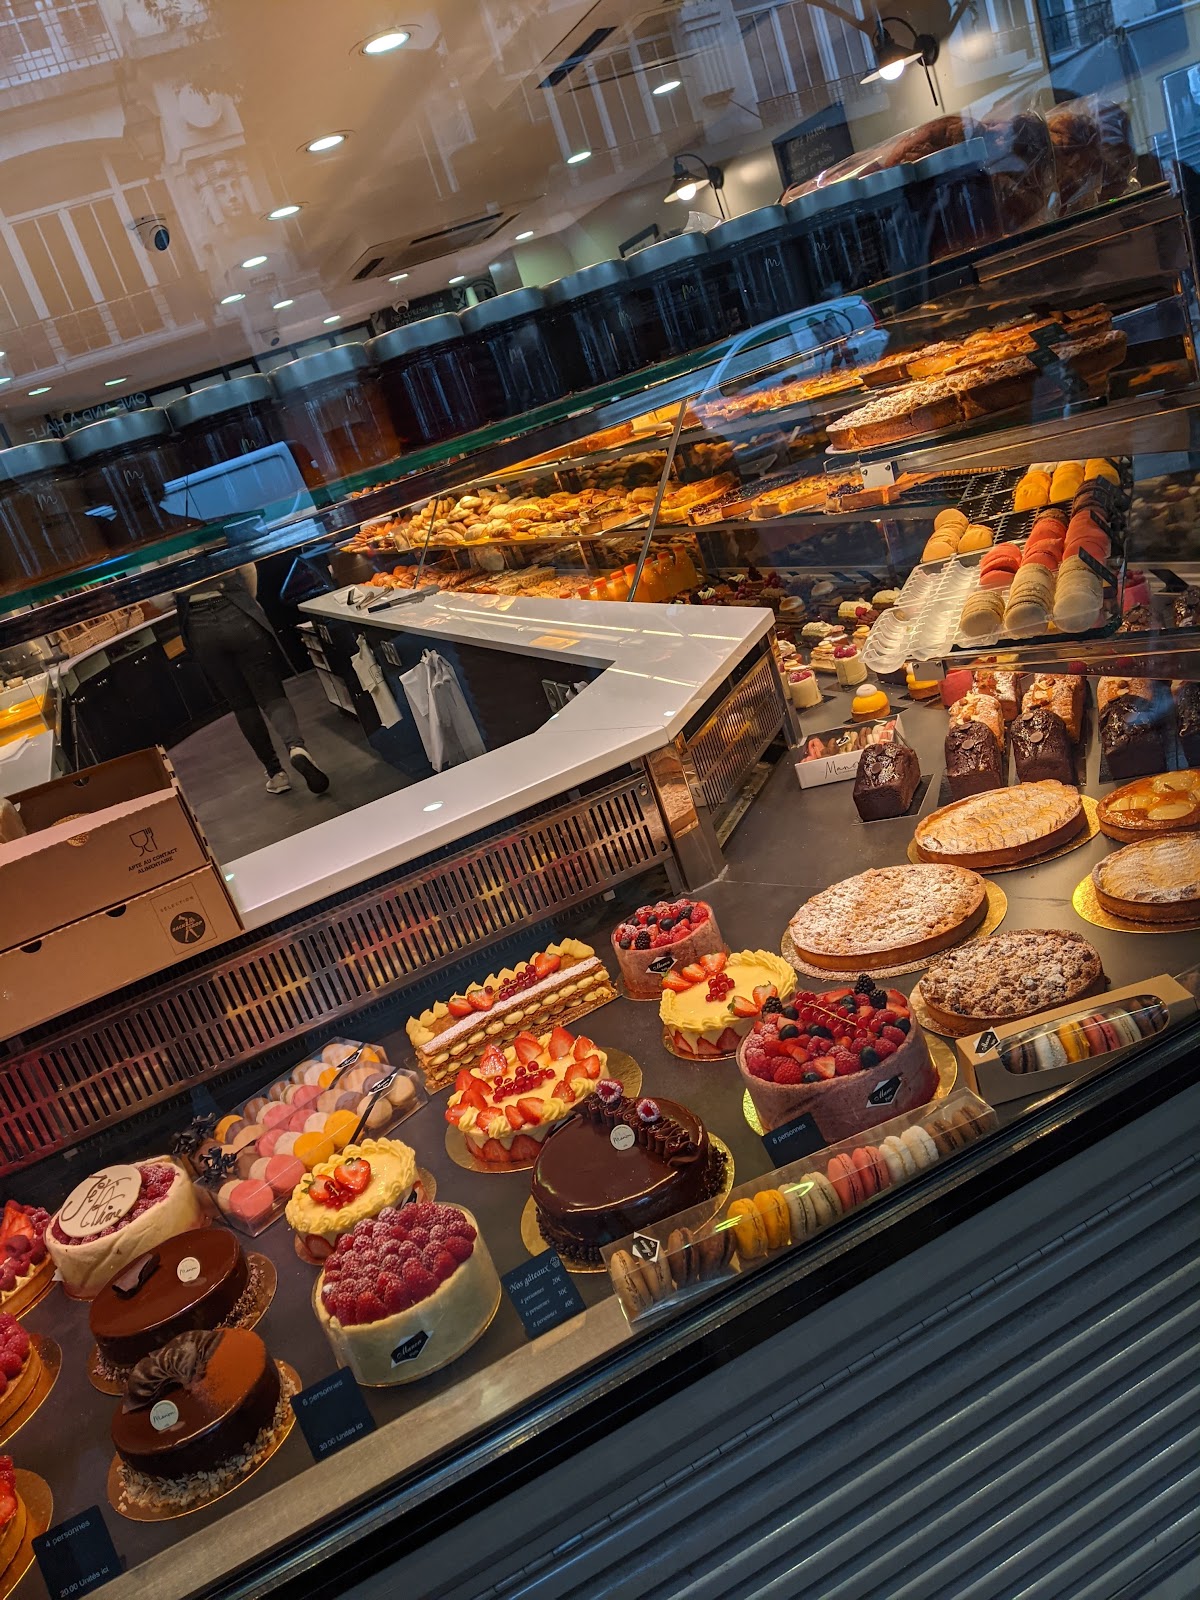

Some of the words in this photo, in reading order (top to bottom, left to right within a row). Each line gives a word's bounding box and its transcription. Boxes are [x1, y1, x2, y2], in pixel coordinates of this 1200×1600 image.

[825, 760, 858, 779] Mano
[128, 862, 143, 872] APTE
[143, 858, 152, 867] AU
[152, 847, 178, 861] CONTACT
[137, 856, 174, 874] ALIMENTAIRE
[777, 1123, 806, 1143] personnes
[509, 1279, 523, 1294] Nos
[523, 1264, 552, 1287] gâteaux
[523, 1287, 545, 1305] personnes
[529, 1299, 550, 1316] personnes
[536, 1310, 558, 1327] personnes
[302, 1398, 308, 1406] 6
[308, 1380, 343, 1404] personnes
[319, 1437, 337, 1451] 30.00
[355, 1422, 364, 1430] ici
[45, 1540, 51, 1548] 4
[52, 1520, 91, 1545] personnes
[60, 1582, 79, 1598] 20.00
[101, 1565, 110, 1575] ici
